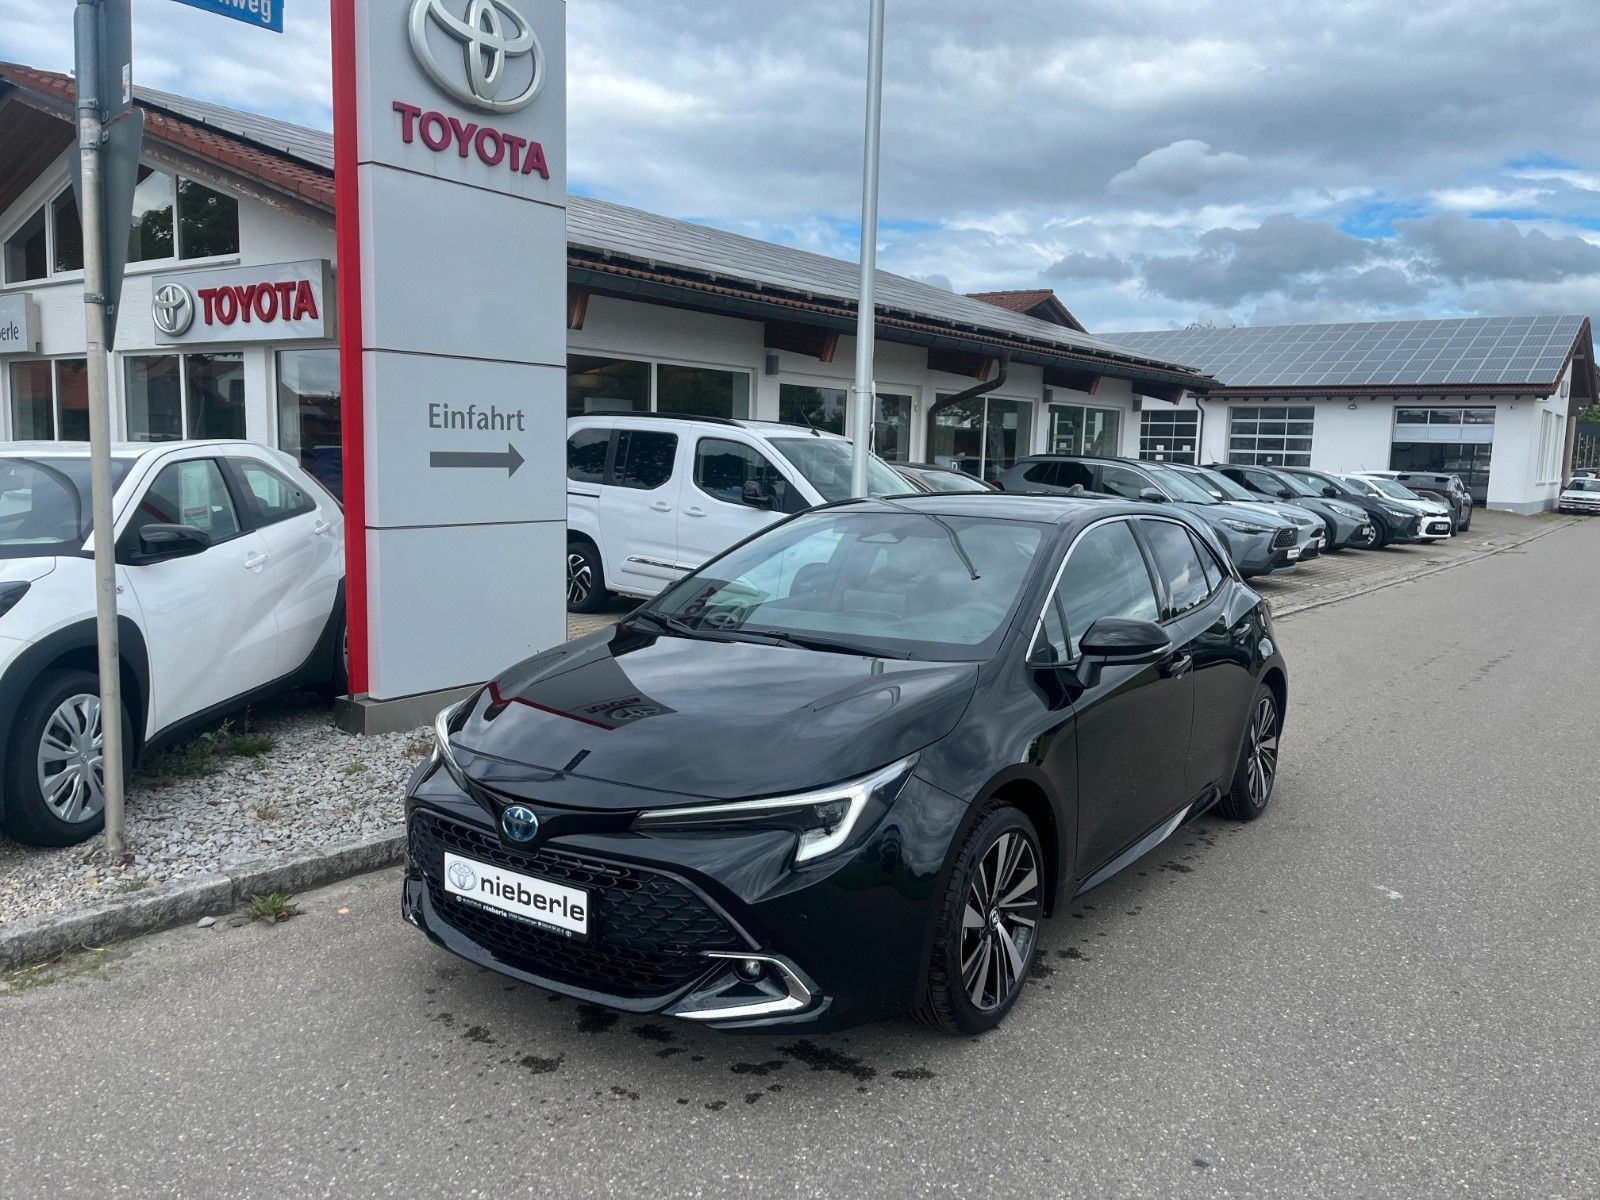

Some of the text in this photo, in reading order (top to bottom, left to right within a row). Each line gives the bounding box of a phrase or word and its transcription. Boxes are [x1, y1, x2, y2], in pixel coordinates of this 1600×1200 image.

[218, 0, 271, 23] weg
[392, 100, 550, 180] TOYOTA
[197, 280, 318, 325] TOYOTA
[0, 321, 19, 341] erle
[428, 402, 525, 431] Einfahrt
[480, 875, 585, 922] nieberle
